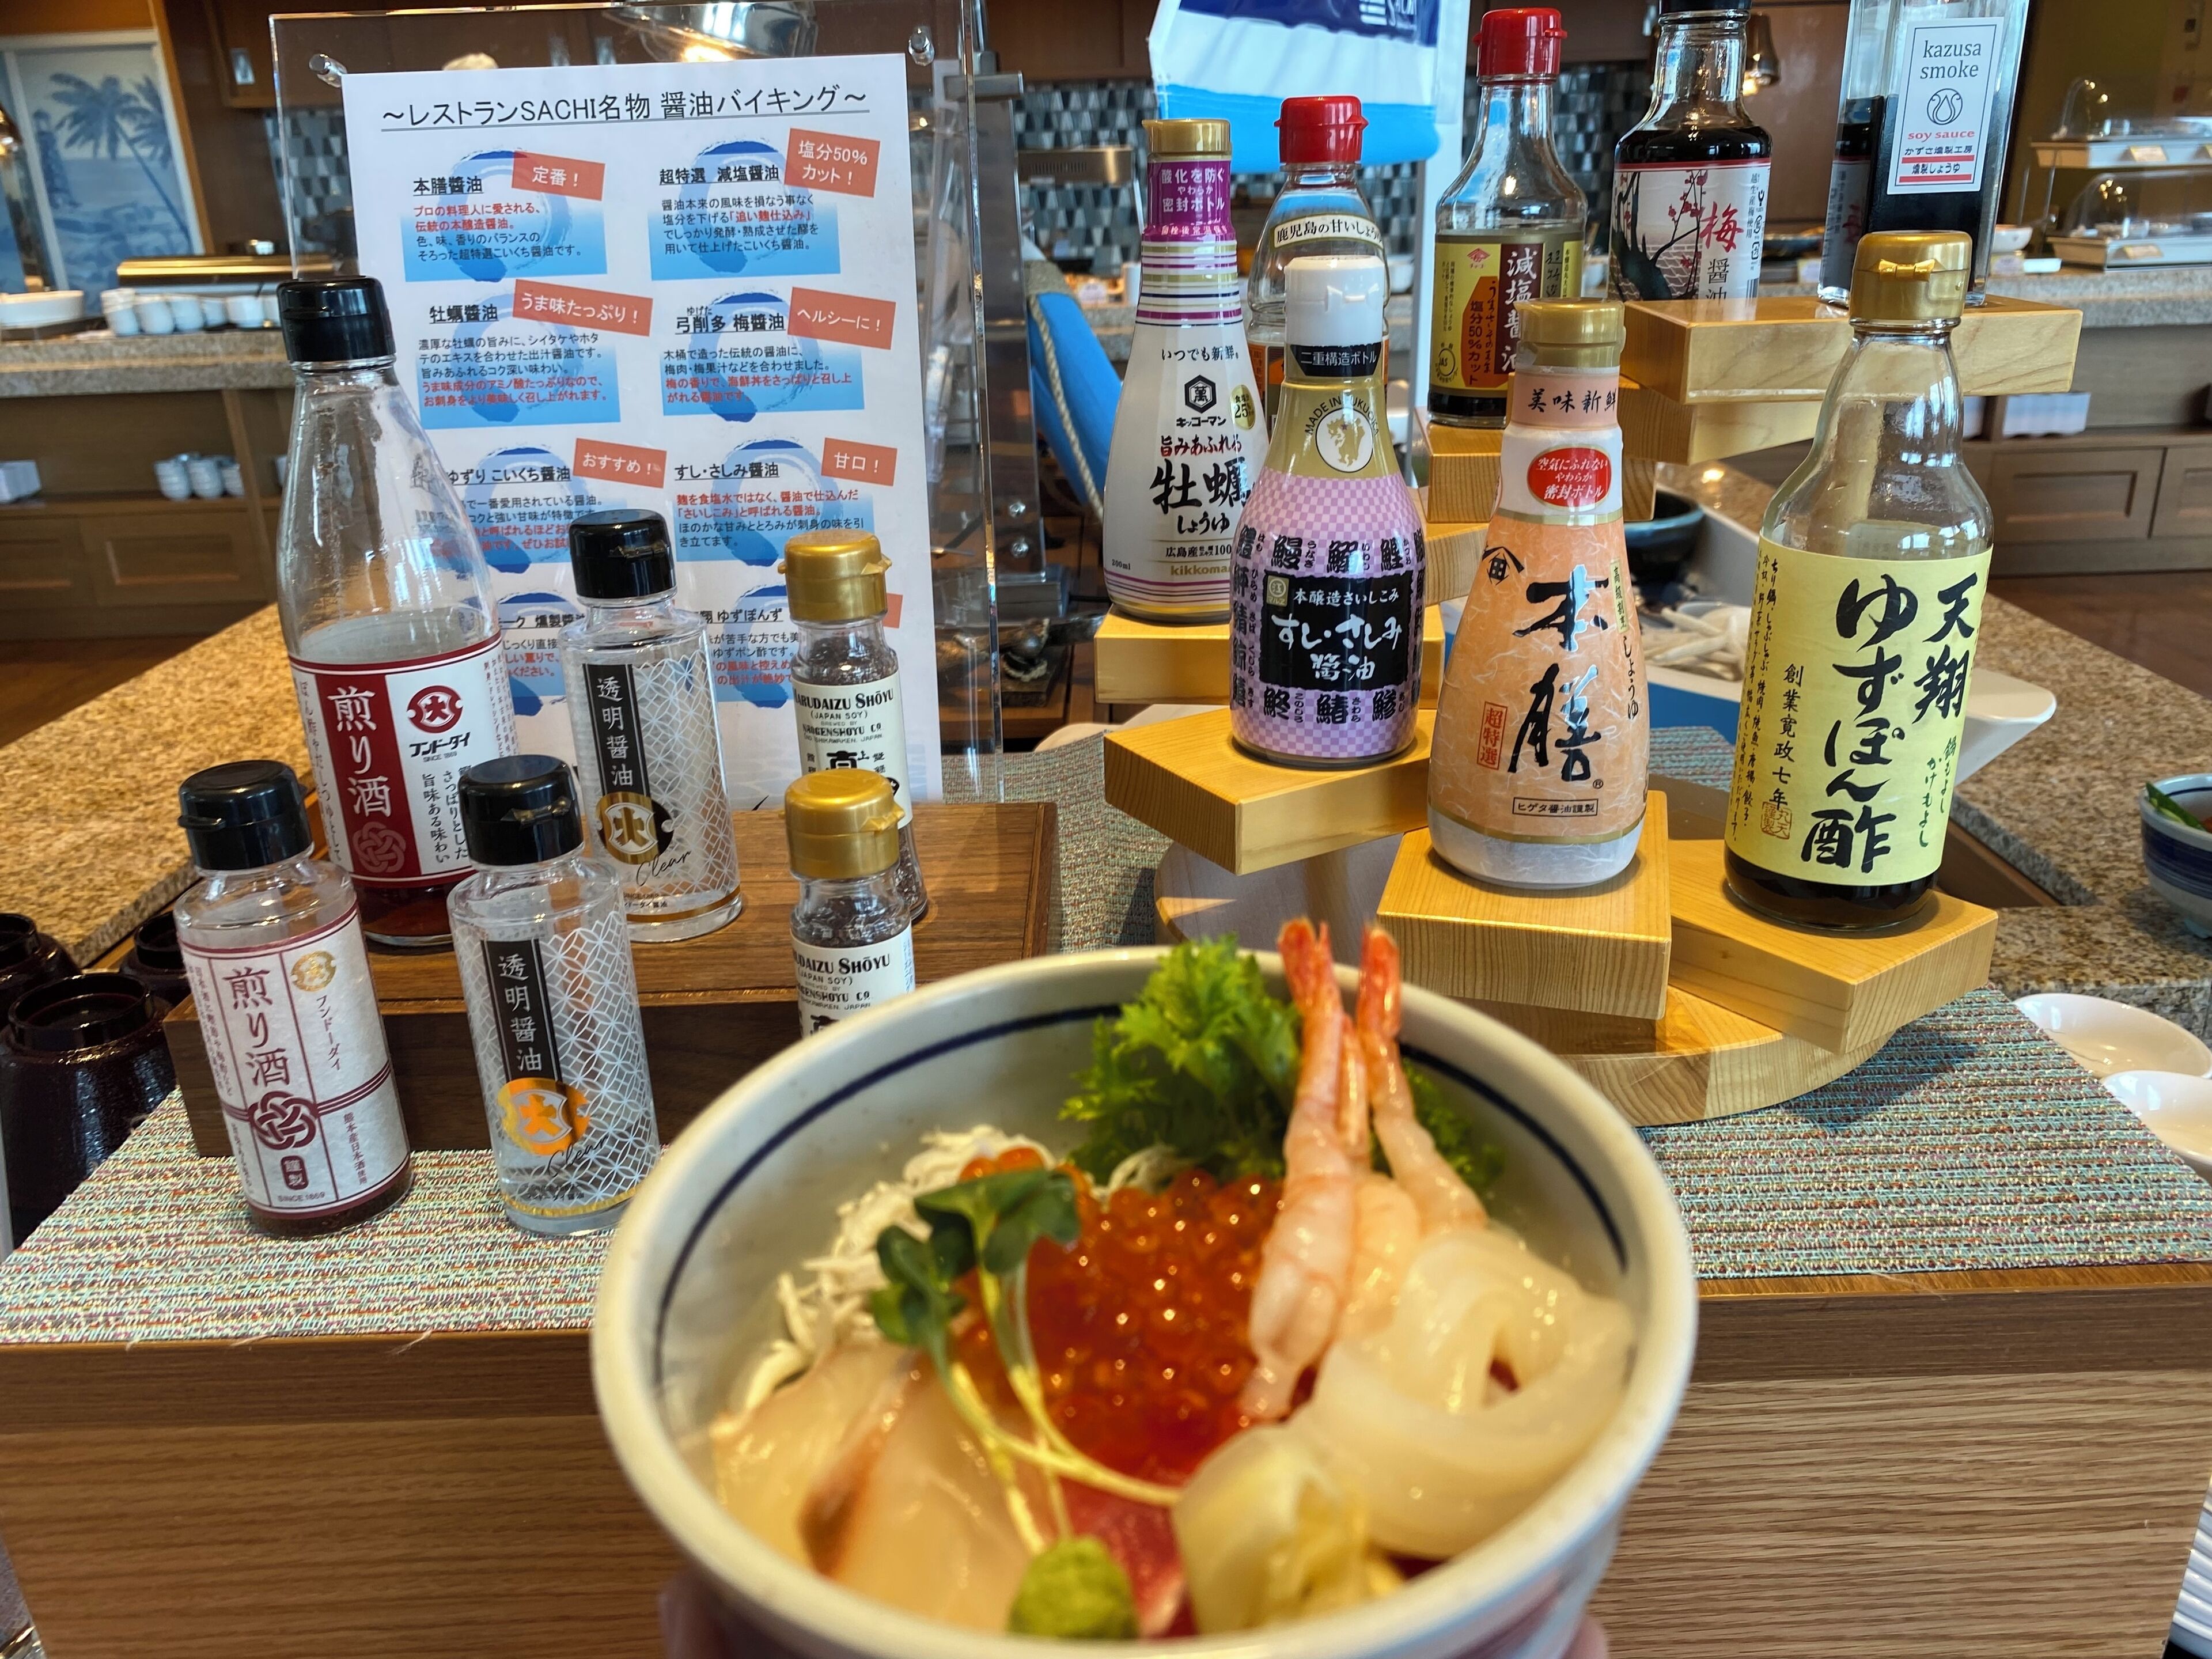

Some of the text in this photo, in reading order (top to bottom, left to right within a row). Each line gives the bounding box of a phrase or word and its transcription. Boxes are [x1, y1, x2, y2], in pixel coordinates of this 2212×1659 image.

[1923, 40, 1982, 58] kazusa
[1919, 60, 1979, 79] smoke
[1908, 130, 1975, 143] soy sauce
[798, 140, 868, 165] 塩分50%
[532, 165, 579, 187] 定番！
[659, 168, 706, 184] 超特選
[802, 164, 853, 185] カット！
[1161, 168, 1225, 184] 酸化を防ぐ
[1177, 185, 1214, 195] やわらか
[413, 203, 541, 217] プロの料理人に愛される、
[1162, 197, 1225, 213] 密封ボトル
[416, 232, 540, 247] 色、味、香りのバランスの
[521, 293, 638, 324] うま味たっぷり！
[676, 315, 726, 333] 弓削多
[797, 309, 881, 331] ヘルシーに！
[1300, 350, 1377, 367] 二重構造ボトル
[422, 364, 569, 379] 旨みあふれるコク深い味わい。
[1528, 388, 1616, 413] 美味新鮮
[1176, 416, 1227, 427] キッコーマン
[1304, 402, 1326, 434] MADE
[1329, 396, 1342, 408] IN
[1160, 434, 1243, 457] 旨みあふれる
[582, 453, 651, 475] おすすめ！
[834, 452, 879, 473] 甘口！
[1536, 457, 1608, 471] 空気にふれない
[1555, 473, 1593, 483] やわらか
[1544, 484, 1604, 500] 密封ボトル
[1177, 514, 1231, 535] しょうゆ
[680, 535, 738, 548] き立てます。
[1112, 559, 1131, 570] 200ml
[1293, 587, 1400, 607] 本醸造さいしこみ
[1271, 613, 1403, 651] すし・さしみ
[810, 709, 868, 719] (JAPAN SOY)
[596, 676, 634, 787] 透明醤油
[1479, 707, 1505, 766] 超特選
[1769, 664, 1804, 810] 創業寛政七年
[327, 685, 392, 818] 煎り酒
[422, 774, 450, 863] 旨味ある味わい
[636, 851, 692, 887] Clear
[828, 976, 853, 986] SOY)
[497, 952, 543, 1073] 透明醤油
[222, 967, 291, 1088] 煎り酒
